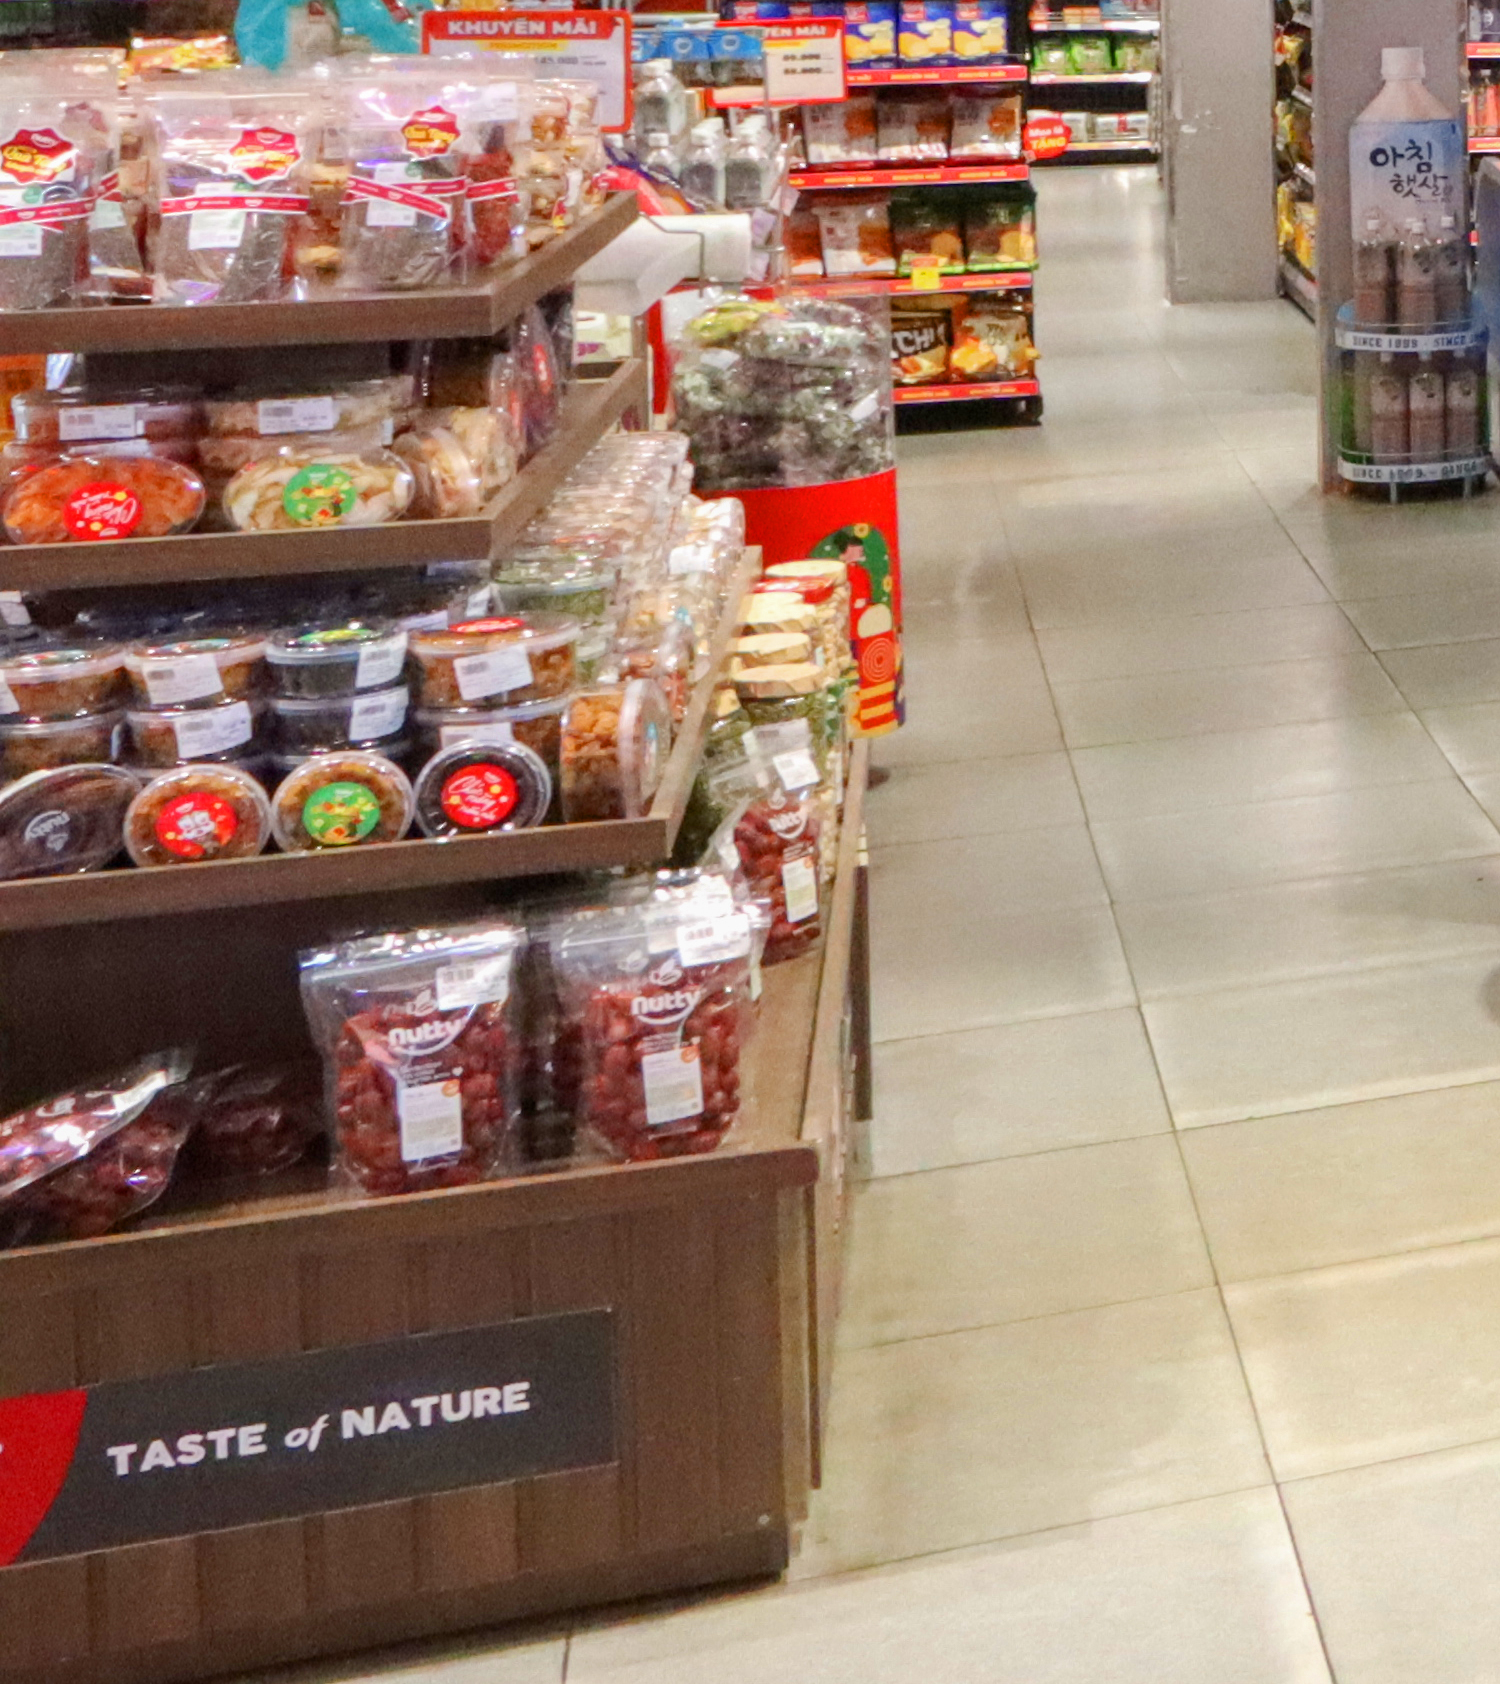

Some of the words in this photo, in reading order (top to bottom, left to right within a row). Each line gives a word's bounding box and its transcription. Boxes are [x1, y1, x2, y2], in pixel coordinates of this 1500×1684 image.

[446, 16, 545, 37] KHUYẾN
[551, 15, 598, 37] MÃI
[1369, 139, 1433, 175] 아침
[632, 989, 701, 1015] nutty
[387, 1017, 464, 1048] nutty
[107, 1423, 267, 1476] TASTE
[284, 1414, 329, 1453] of
[341, 1382, 532, 1440] NATURE
